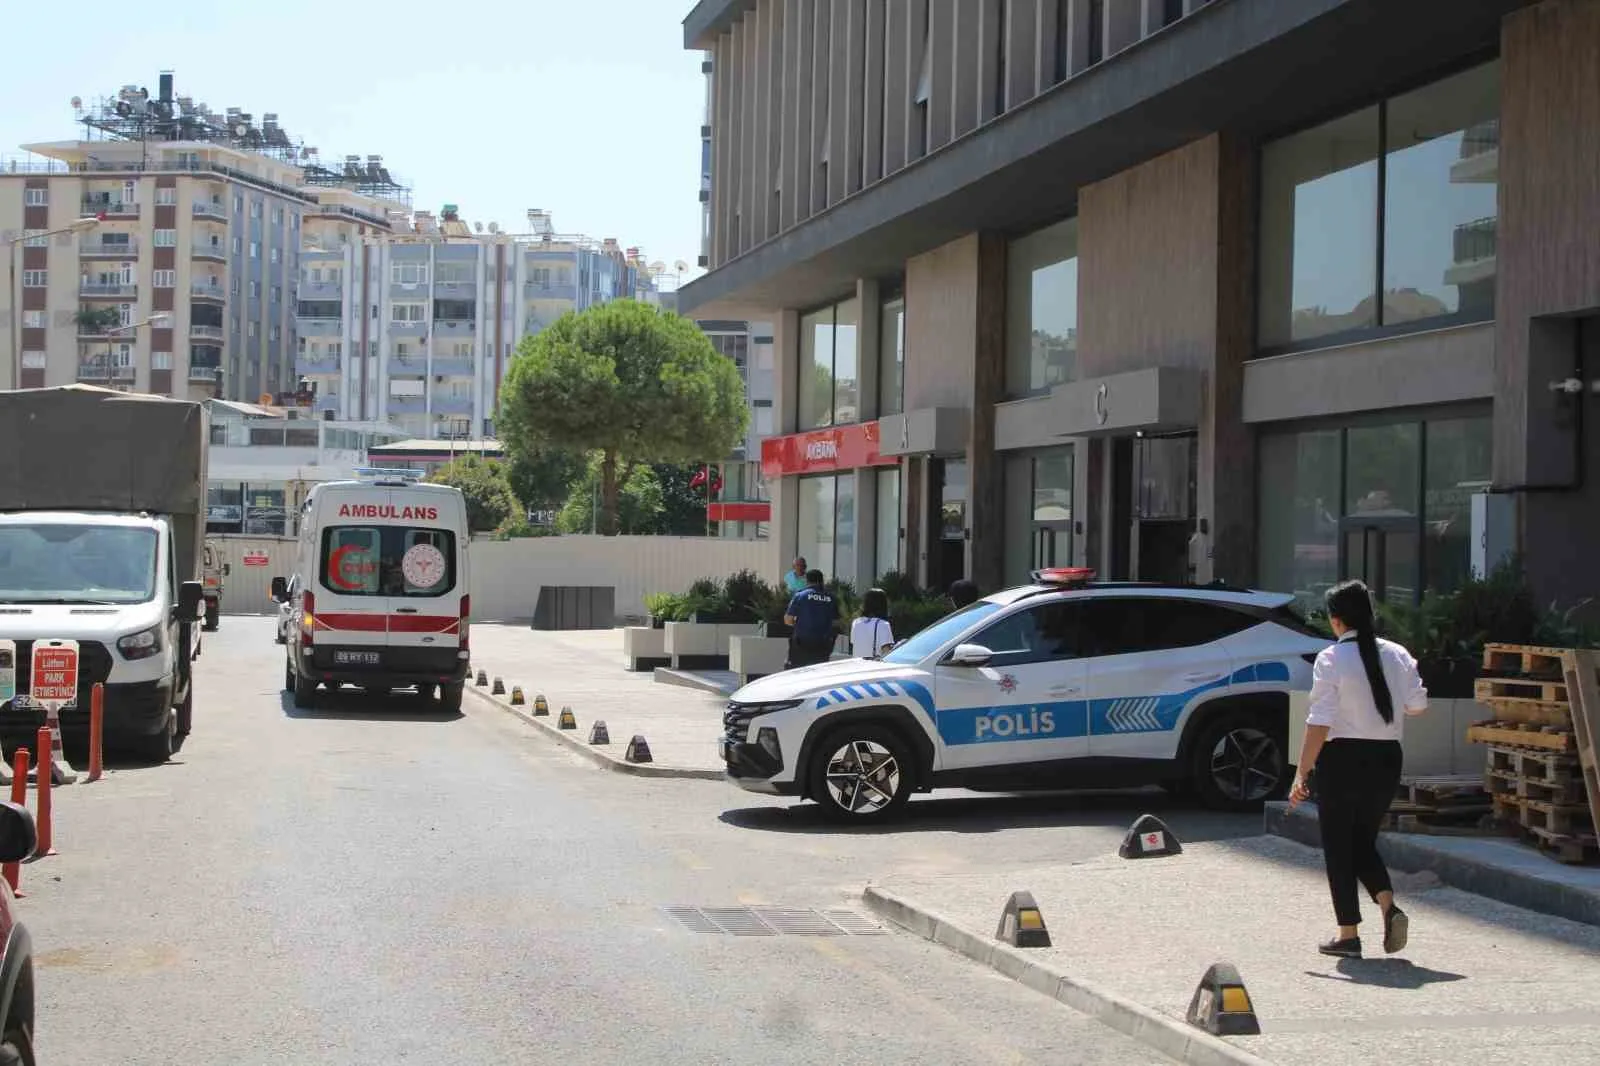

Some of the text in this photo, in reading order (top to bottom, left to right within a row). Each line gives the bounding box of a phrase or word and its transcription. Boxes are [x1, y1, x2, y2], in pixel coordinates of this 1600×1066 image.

[339, 504, 438, 520] AMBULANS
[44, 672, 65, 683] PARK
[975, 706, 1056, 737] POLİS
